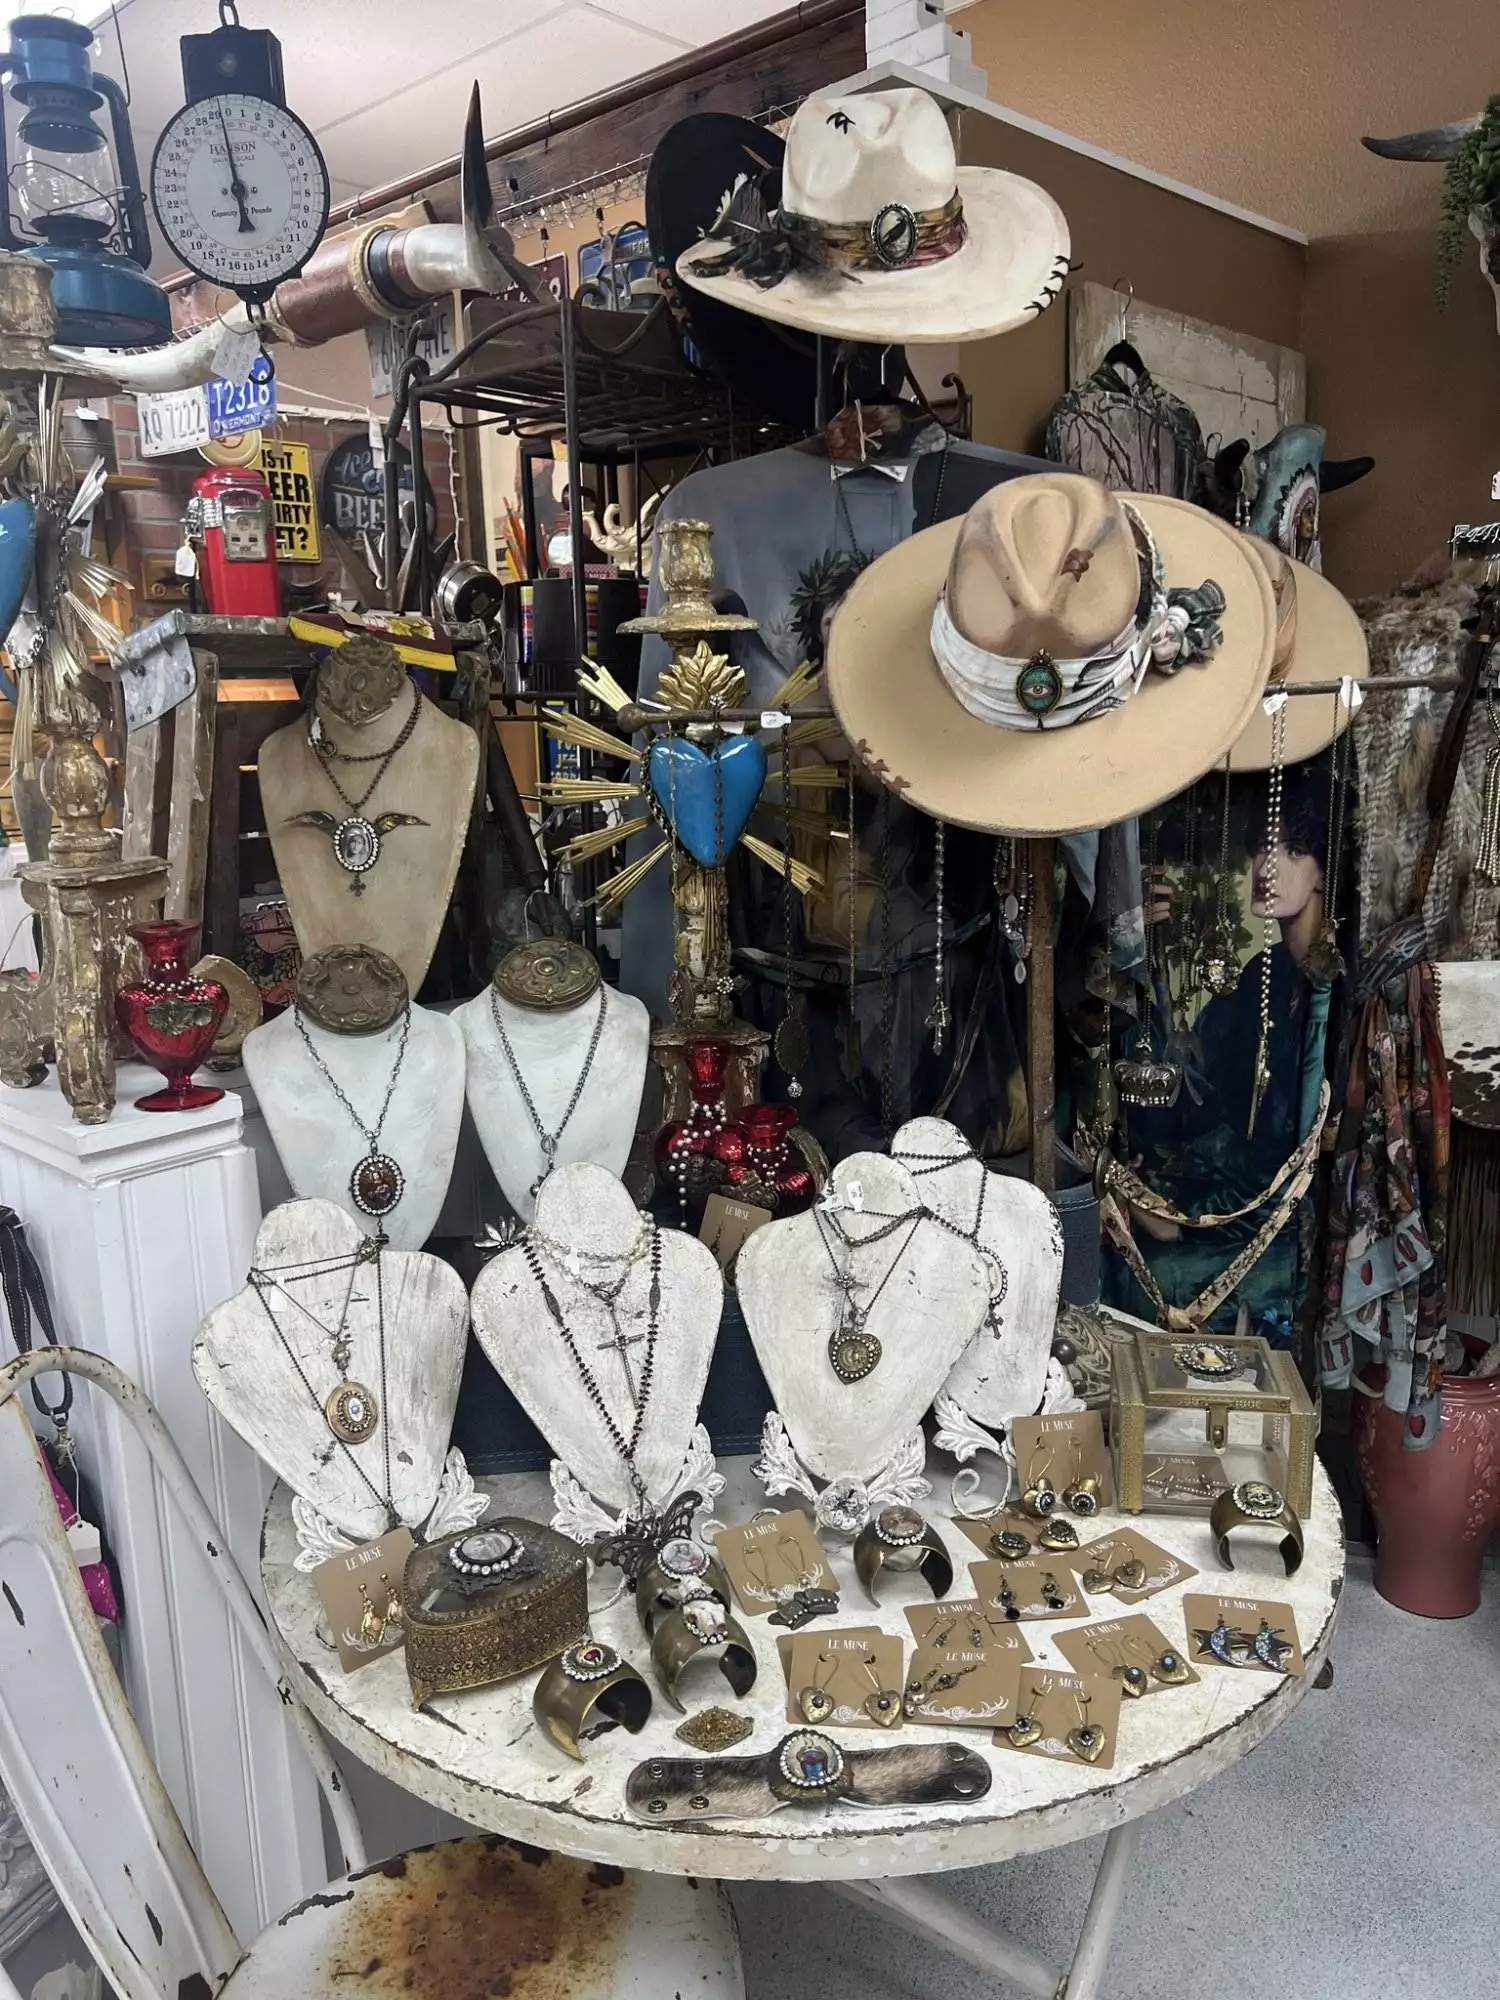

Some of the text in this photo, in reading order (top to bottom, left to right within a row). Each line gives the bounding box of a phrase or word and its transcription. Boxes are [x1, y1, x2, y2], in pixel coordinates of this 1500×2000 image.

[225, 108, 232, 116] 0
[241, 109, 245, 117] 1
[254, 112, 261, 120] 2
[195, 117, 208, 126] 28
[268, 120, 274, 128] 3
[184, 127, 195, 136] 27
[281, 130, 286, 139] 4
[175, 138, 188, 147] 26
[290, 142, 296, 151] 5
[168, 152, 181, 161] 25
[298, 157, 304, 166] 6
[165, 168, 177, 177] 24
[303, 173, 308, 182] 7
[165, 184, 177, 192] 23
[304, 188, 311, 197] 8
[167, 200, 179, 208] 22
[303, 204, 309, 213] 9
[172, 216, 184, 224] 21
[296, 220, 308, 229] 10
[180, 229, 192, 238] 20
[290, 233, 300, 241] 11
[190, 241, 202, 250] 19
[280, 244, 292, 253] 12
[202, 251, 214, 260] 18
[270, 254, 281, 262] 13
[215, 258, 226, 266] 17
[229, 261, 240, 270] 16
[257, 260, 268, 268] 14
[243, 263, 254, 271] 15
[261, 449, 276, 469] IS
[257, 470, 310, 503] EER
[275, 503, 311, 524] IRTY
[275, 526, 308, 550] ET?
[1218, 1598, 1259, 1612] LE MUSE
[1083, 1623, 1123, 1637] LE MUSE
[828, 1639, 868, 1650] LE MUSE
[946, 1652, 987, 1661] LE MUSE
